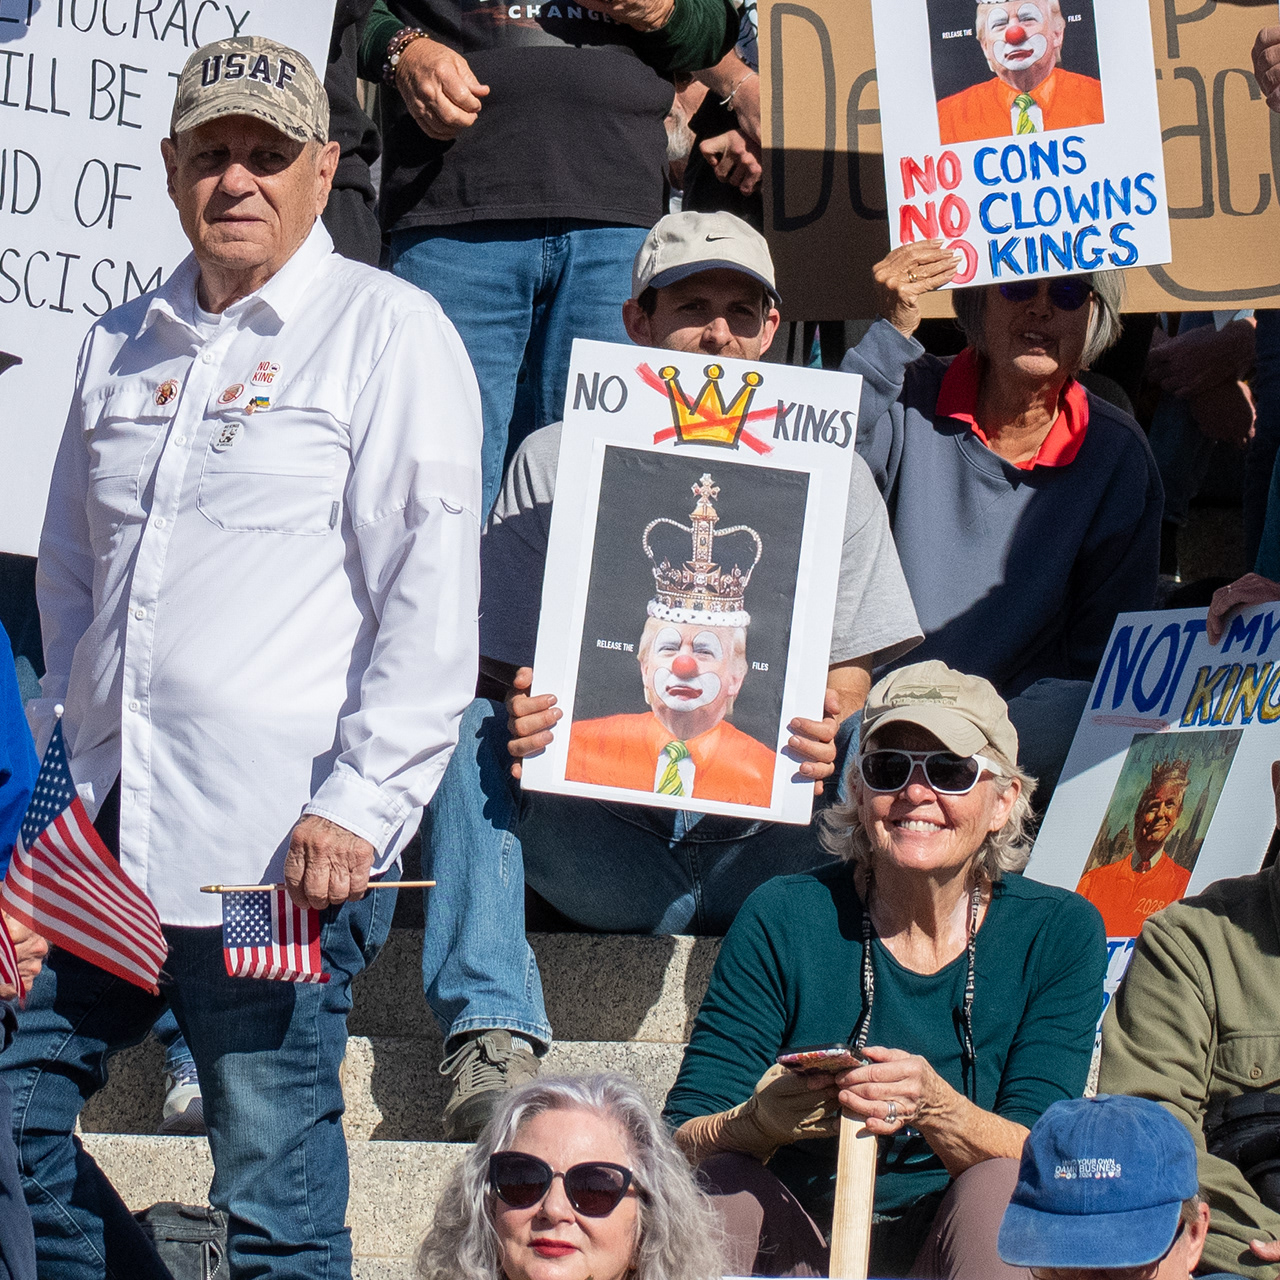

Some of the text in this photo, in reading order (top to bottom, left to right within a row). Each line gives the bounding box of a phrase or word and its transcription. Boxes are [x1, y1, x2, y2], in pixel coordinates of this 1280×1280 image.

[1067, 14, 1082, 23] FILES
[941, 28, 973, 40] RELEASE THE
[201, 53, 297, 90] USAF
[88, 58, 149, 130] BE
[899, 135, 1087, 200] NO CONS
[73, 157, 142, 230] OF
[898, 172, 1158, 245] NO CLOWNS
[945, 222, 1140, 284] O KINGS
[252, 371, 275, 384] KING
[256, 361, 271, 372] NO
[572, 371, 857, 450] NO KINGS
[596, 639, 634, 652] RELEASE THE
[751, 661, 769, 672] FILES
[1090, 619, 1208, 717] NOT
[1055, 1163, 1122, 1174] DAMN BUSINESS
[1097, 1157, 1115, 1165] OWN
